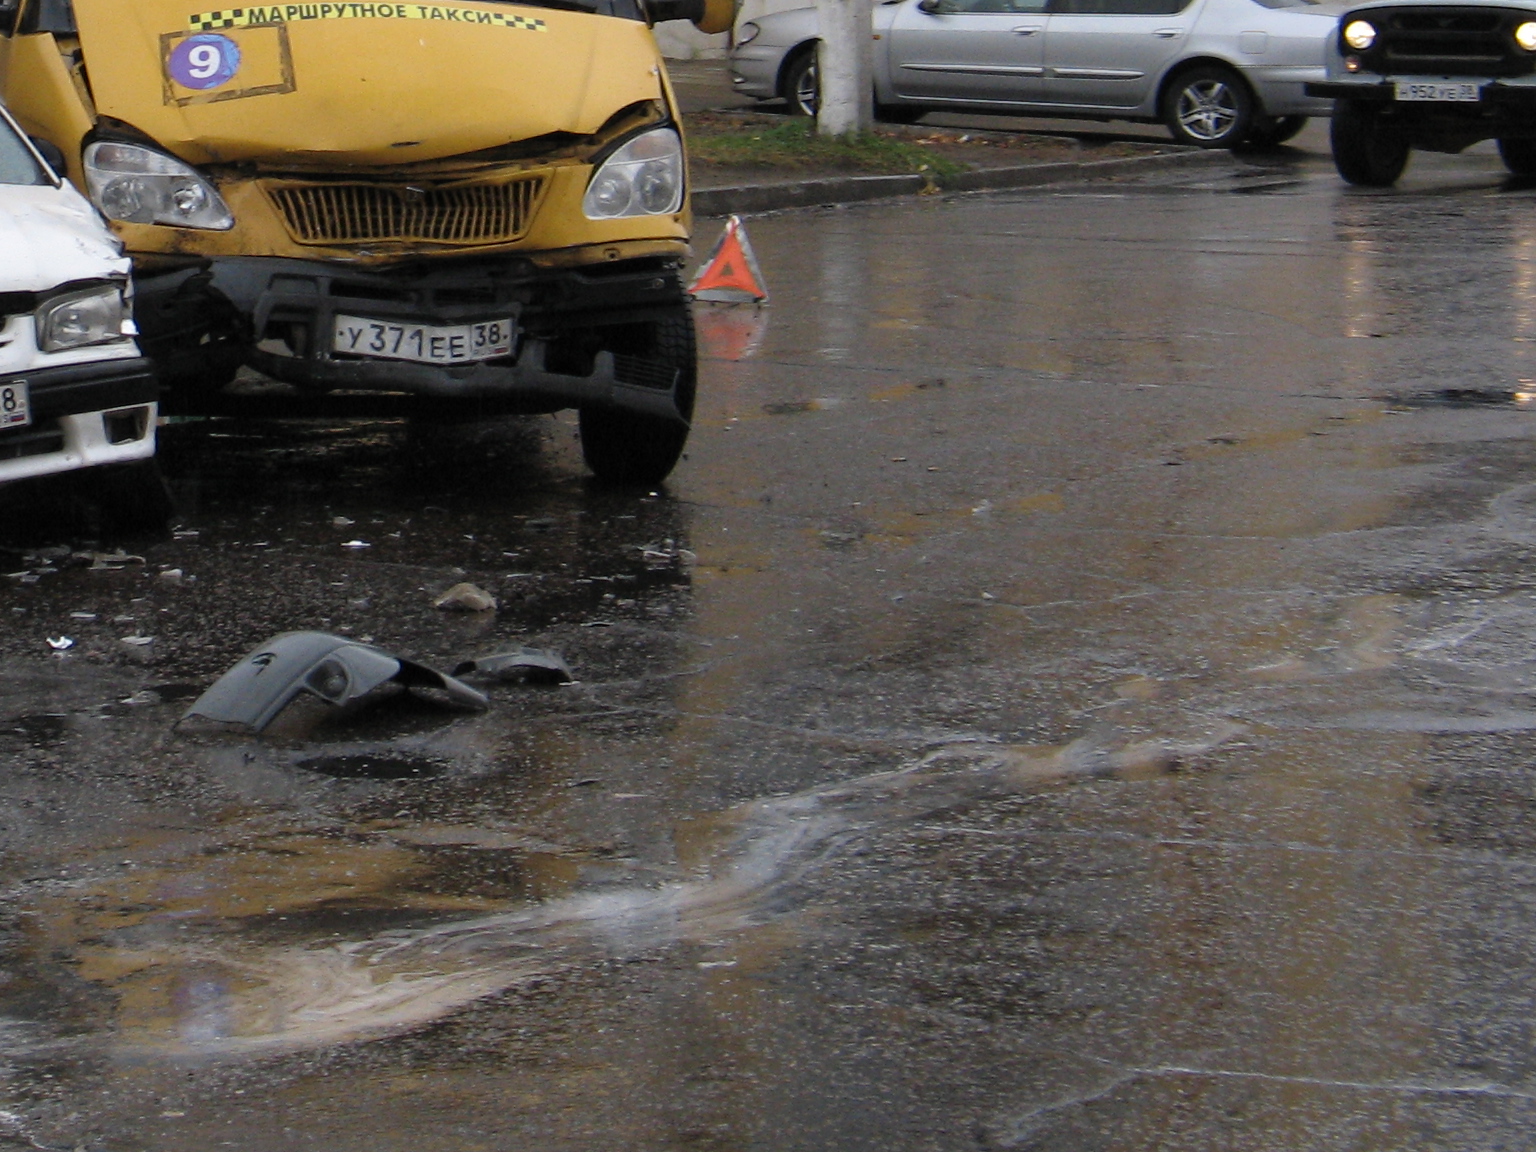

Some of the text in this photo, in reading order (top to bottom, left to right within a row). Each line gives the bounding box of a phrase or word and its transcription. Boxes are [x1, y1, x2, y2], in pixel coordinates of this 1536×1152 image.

[248, 3, 492, 25] МАРШРУТНОЕ ТАКСИ
[188, 45, 222, 79] 9
[348, 323, 501, 359] У371ЕЕ 38
